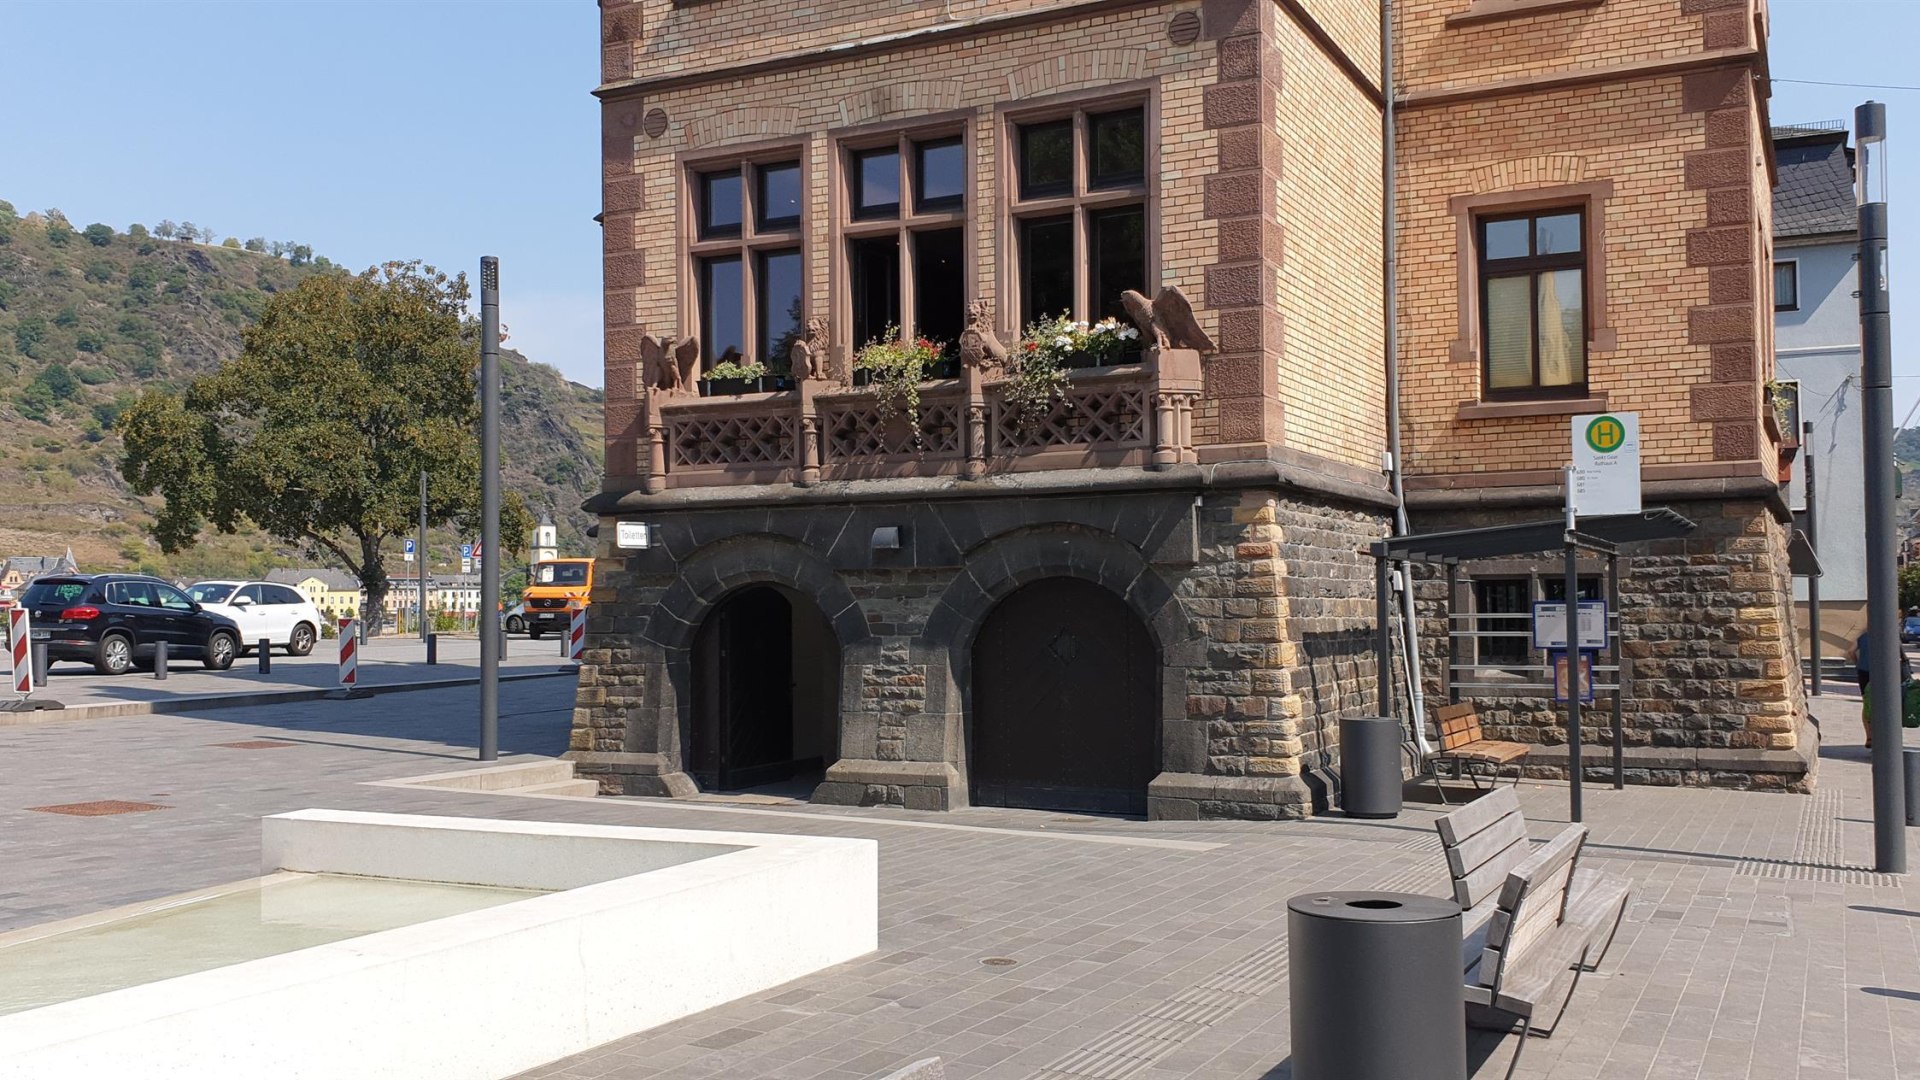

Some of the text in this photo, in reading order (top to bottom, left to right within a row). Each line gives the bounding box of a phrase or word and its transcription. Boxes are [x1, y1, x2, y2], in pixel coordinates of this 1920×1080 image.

[1598, 424, 1613, 444] H
[621, 529, 648, 540] Toiletten
[406, 541, 412, 551] P
